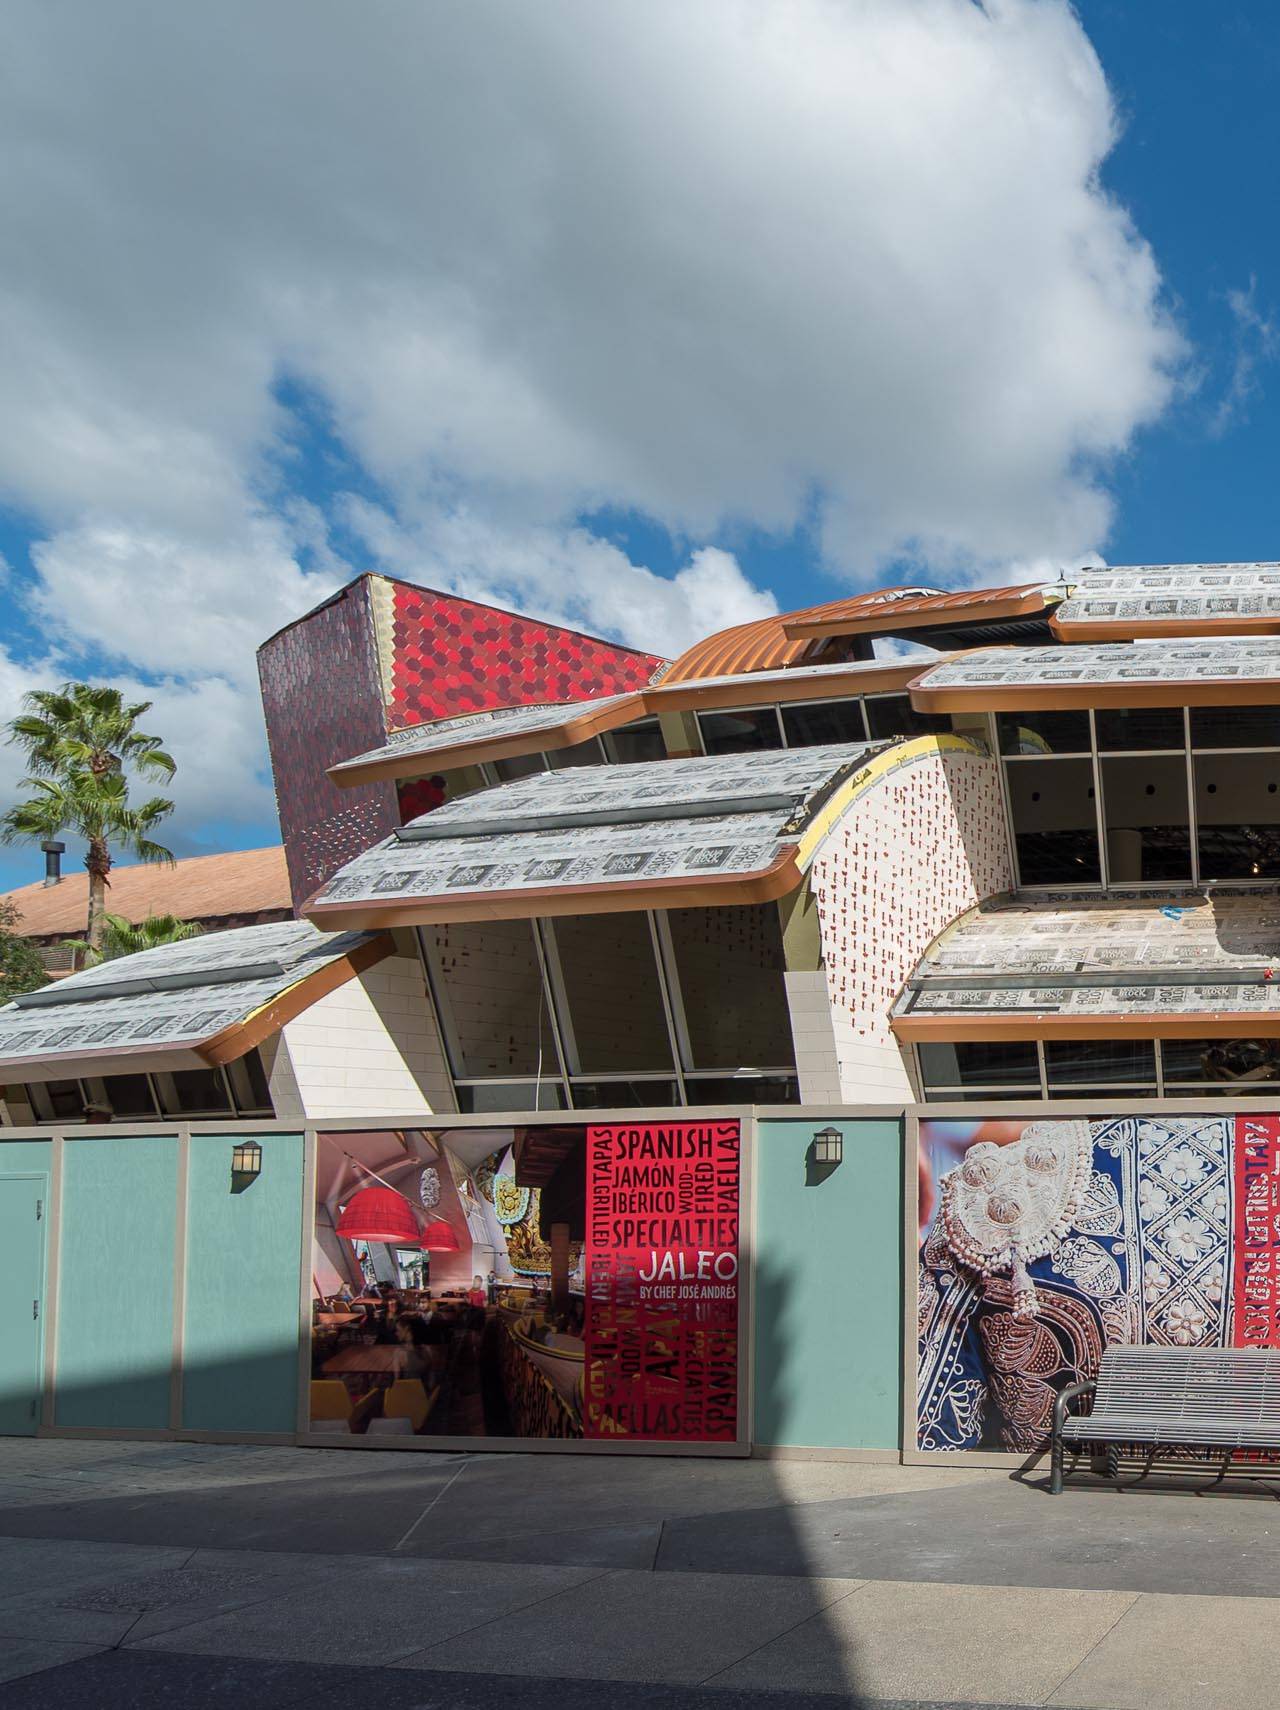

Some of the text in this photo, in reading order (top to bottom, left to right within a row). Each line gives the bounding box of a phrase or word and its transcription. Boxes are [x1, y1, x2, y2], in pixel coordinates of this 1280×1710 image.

[593, 1129, 613, 1184] TAPAS
[616, 1128, 713, 1160] SPANISH
[612, 1162, 675, 1188] JAMÓN
[717, 1126, 739, 1213] PAELLAS
[612, 1189, 675, 1214] IBÉRICO
[679, 1162, 715, 1214] WOOD- FIRED
[592, 1185, 611, 1247] GRILLED
[612, 1218, 738, 1248] SPECIALTIES
[639, 1251, 738, 1281] JALEO
[640, 1283, 737, 1300] BY CHEF JOSÉ ANDRÉS
